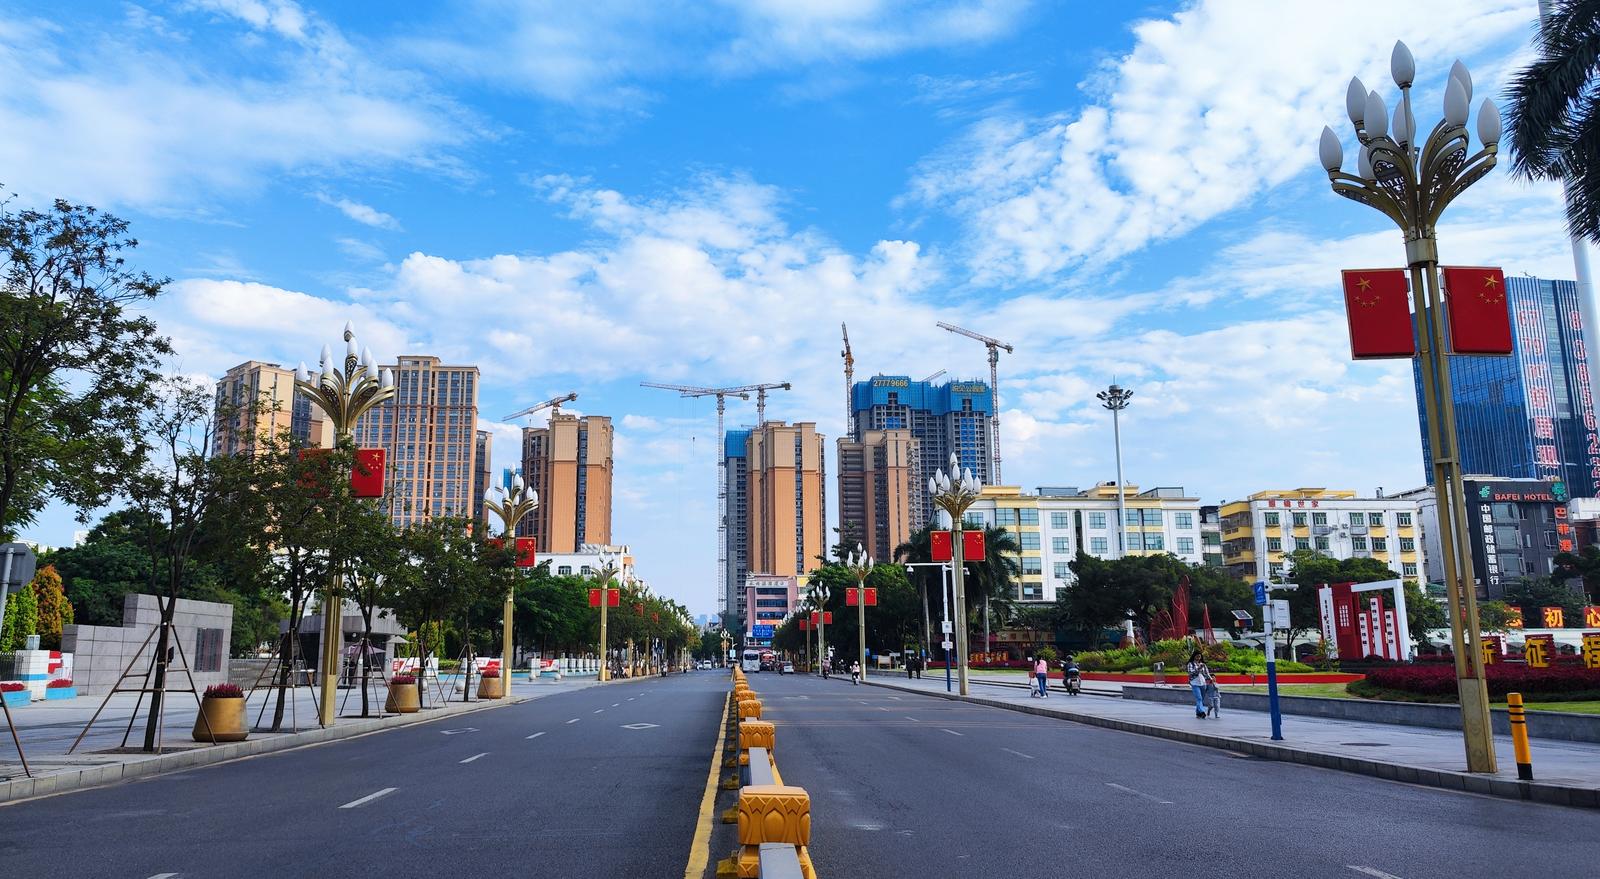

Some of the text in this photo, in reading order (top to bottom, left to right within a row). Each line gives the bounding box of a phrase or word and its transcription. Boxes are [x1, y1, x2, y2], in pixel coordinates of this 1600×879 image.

[1494, 493, 1553, 501] BAFEI HOTEL
[1480, 503, 1500, 585] 中国邮政储蓄银行
